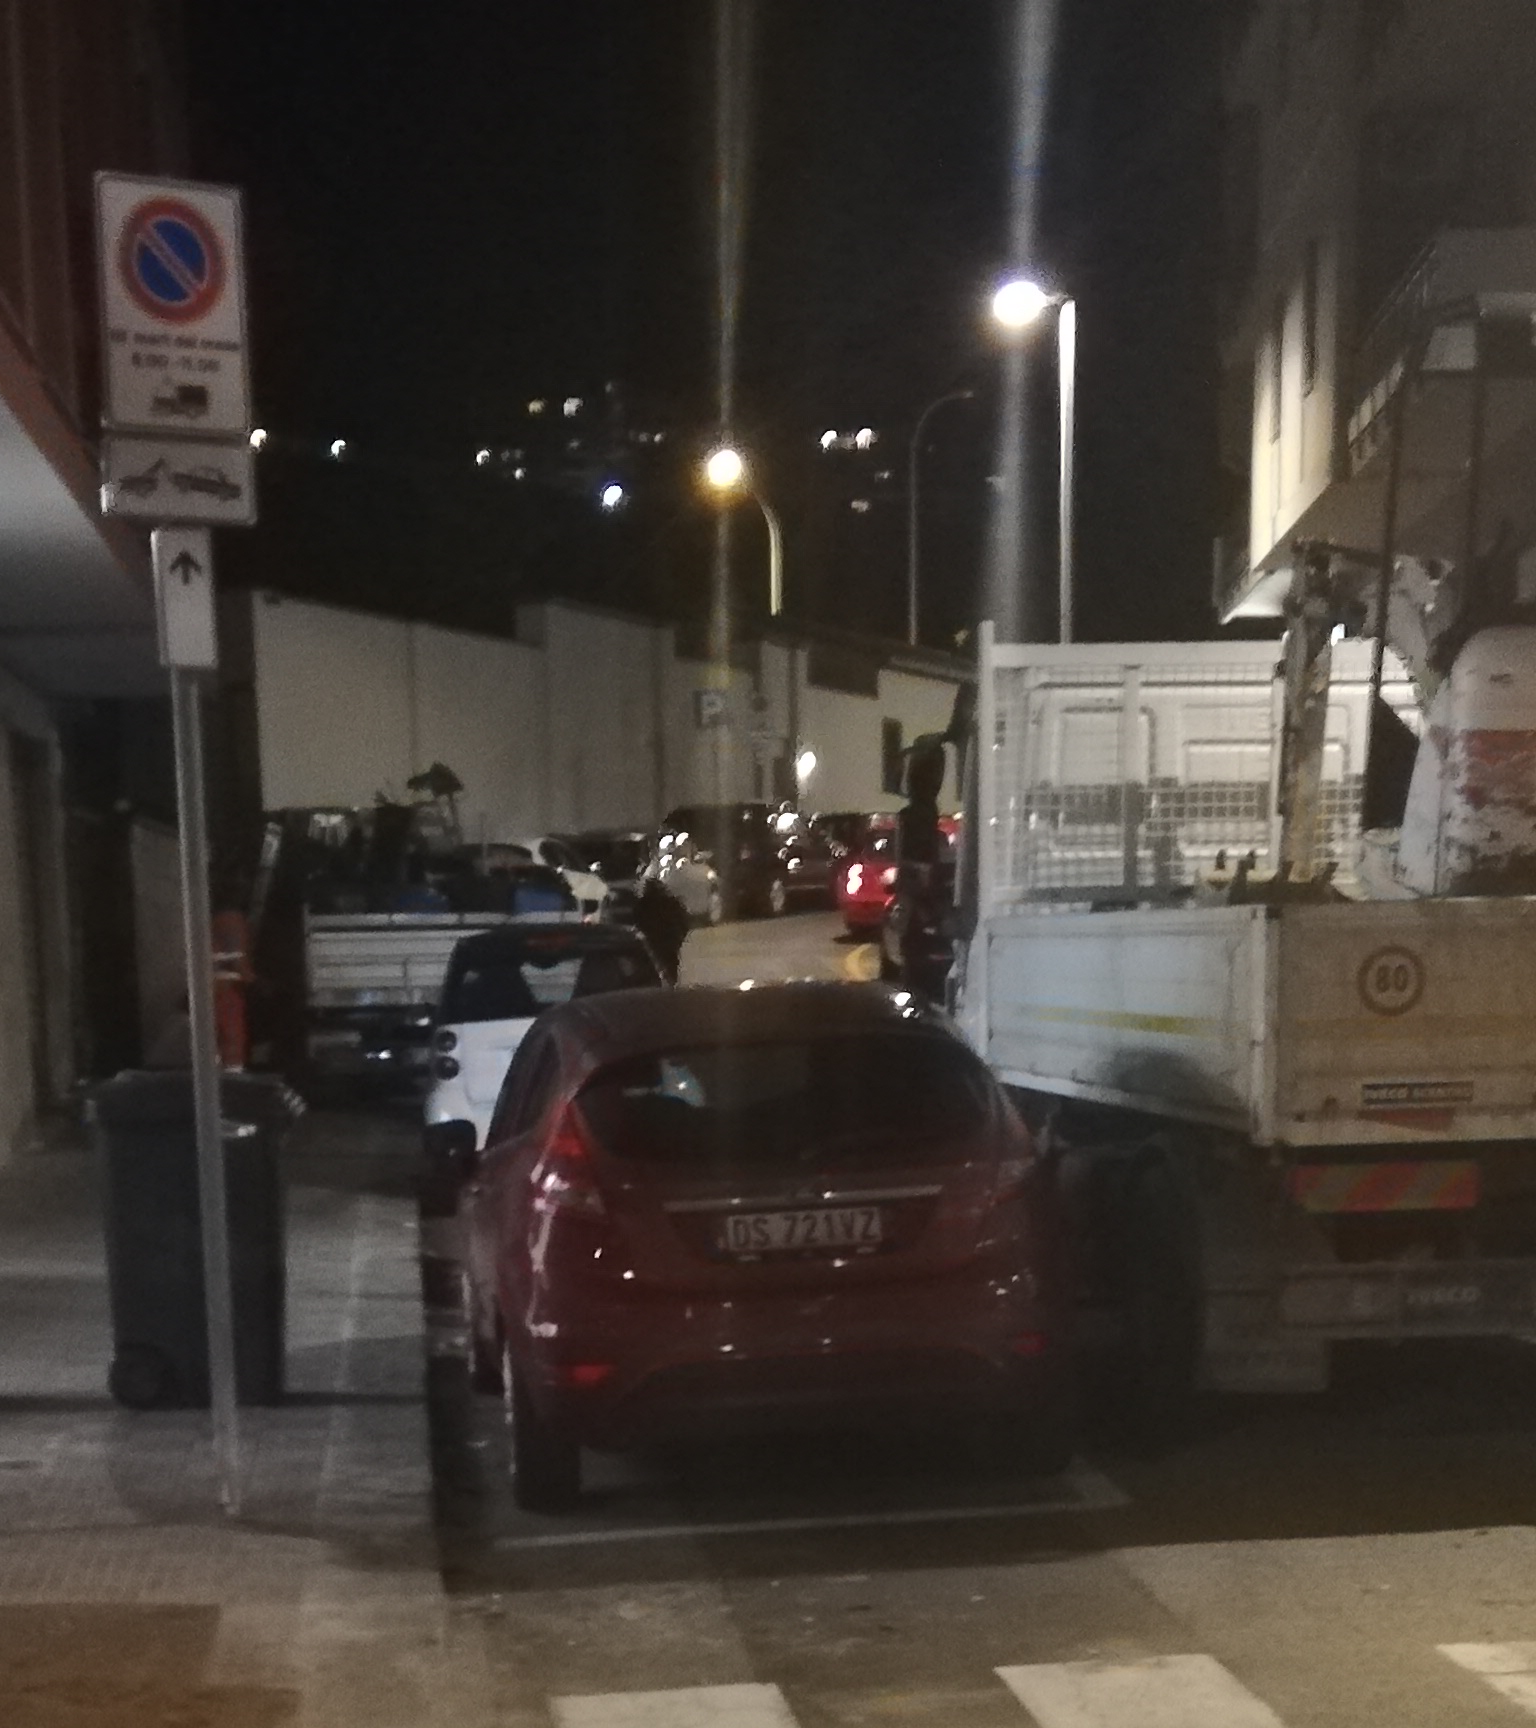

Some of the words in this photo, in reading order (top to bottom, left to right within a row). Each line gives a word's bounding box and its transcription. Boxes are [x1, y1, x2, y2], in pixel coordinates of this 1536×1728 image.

[1375, 964, 1409, 994] 80
[731, 1216, 770, 1248] DS
[782, 1209, 879, 1244] 721VZ
